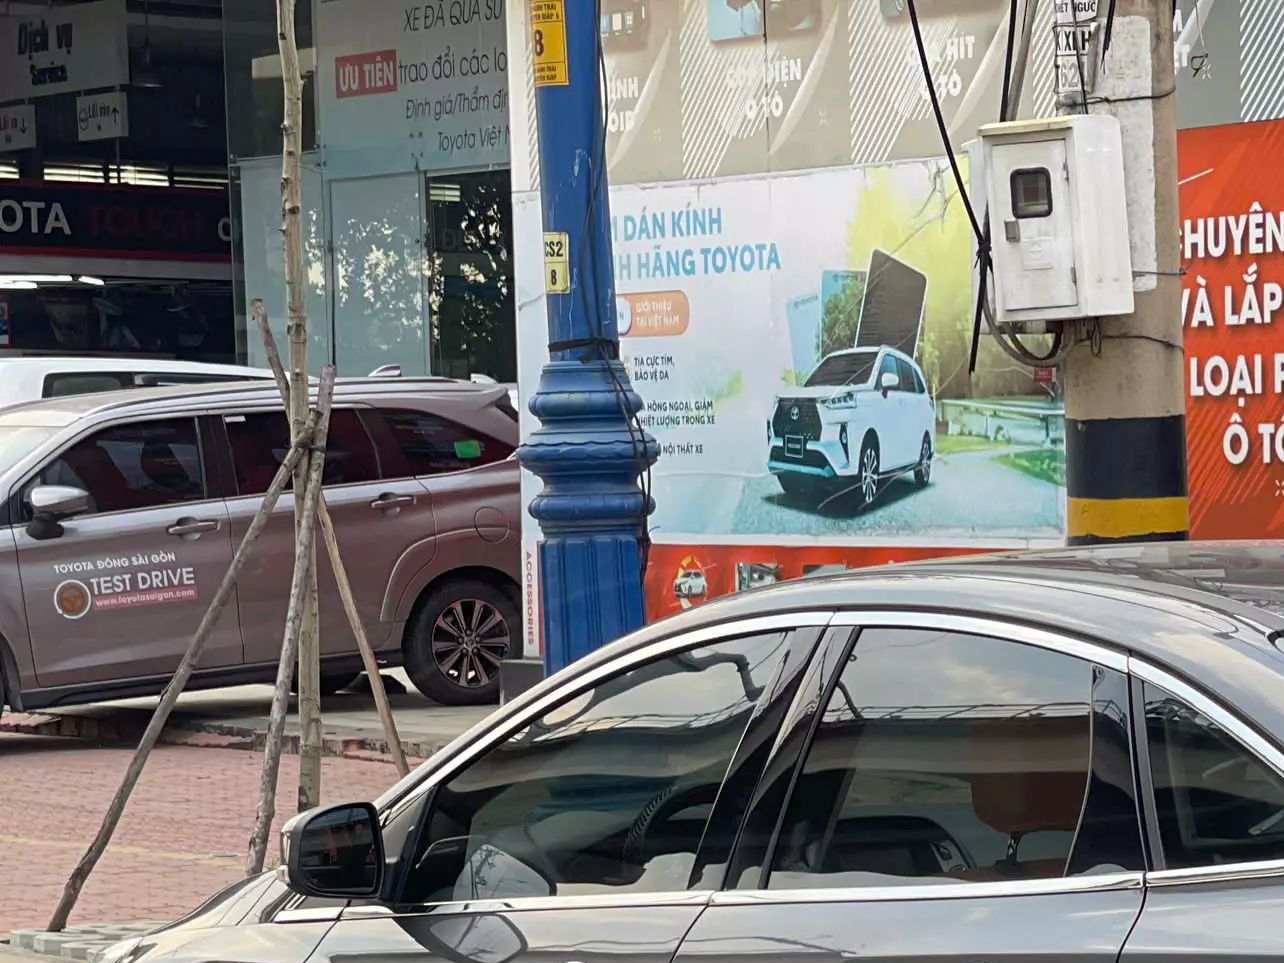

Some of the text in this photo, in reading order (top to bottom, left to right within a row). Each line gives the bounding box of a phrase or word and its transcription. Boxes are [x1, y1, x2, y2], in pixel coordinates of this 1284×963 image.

[404, 7, 420, 32] XE
[450, 0, 482, 26] QUA
[535, 29, 544, 56] 8
[339, 55, 394, 92] ƯU TIÊN
[399, 60, 428, 84] trao
[432, 46, 455, 80] đổi
[460, 49, 489, 77] các
[438, 129, 476, 153] Toyota
[479, 126, 502, 150] Việt
[0, 199, 71, 235] OTA
[624, 206, 666, 241] DÁN
[671, 202, 722, 237] KÍNH
[637, 245, 696, 280] HÃNG
[700, 243, 781, 275] TOYOTA
[551, 269, 557, 286] 8
[1224, 262, 1282, 325] LẮP
[634, 353, 675, 368] TIA CỰC TÍM,
[649, 367, 658, 383] VỆ
[660, 370, 669, 380] DA
[1190, 354, 1262, 407] LOẠI
[695, 398, 713, 411] GIẢM
[656, 415, 680, 428] LƯỢNG
[682, 415, 705, 425] TRONG
[707, 415, 715, 425] XE
[663, 441, 703, 456] NỘI THẤT XE
[1223, 412, 1249, 465] Ô
[54, 550, 176, 574] TOYOTA ĐÔNG SÀI GÒN
[90, 568, 195, 595] TEST DRIVE
[526, 551, 534, 645] ACCESSORIES
